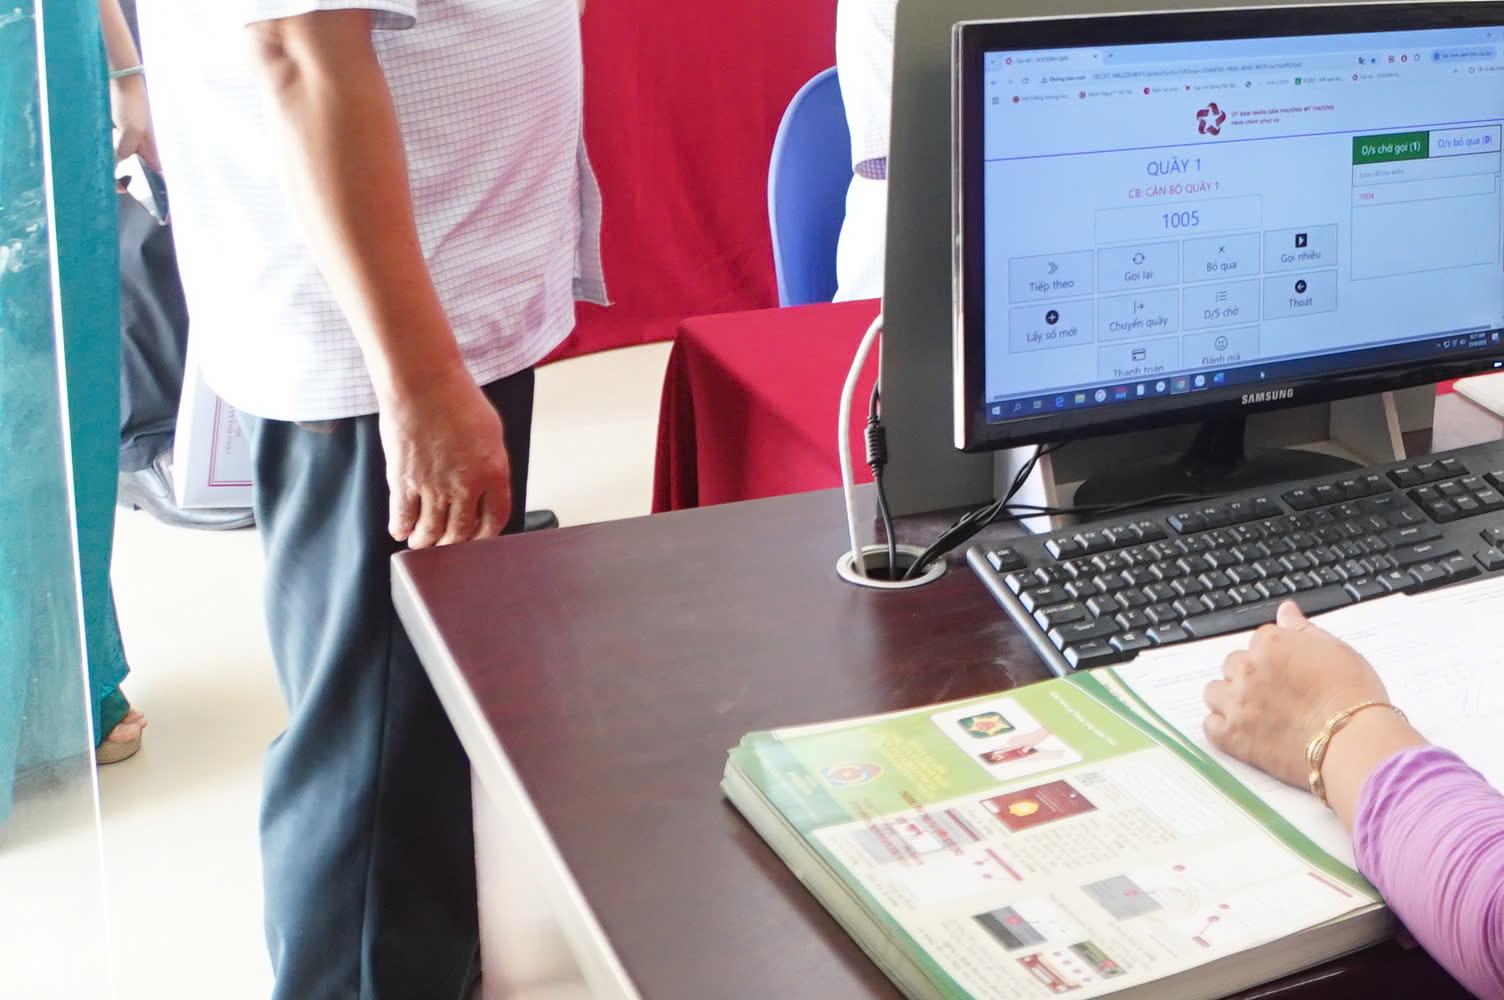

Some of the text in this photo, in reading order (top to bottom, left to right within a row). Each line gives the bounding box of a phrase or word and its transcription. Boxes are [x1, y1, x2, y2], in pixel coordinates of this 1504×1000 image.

[1361, 145, 1376, 156] D/s
[1409, 140, 1421, 152] (1)
[1196, 158, 1201, 173] 1
[1162, 210, 1200, 229] 1005
[1220, 261, 1237, 273] qua
[1052, 279, 1075, 290] theo
[1288, 297, 1313, 309] Thoát
[1204, 308, 1221, 320] D/S
[1241, 387, 1294, 405] SAMSUNG
